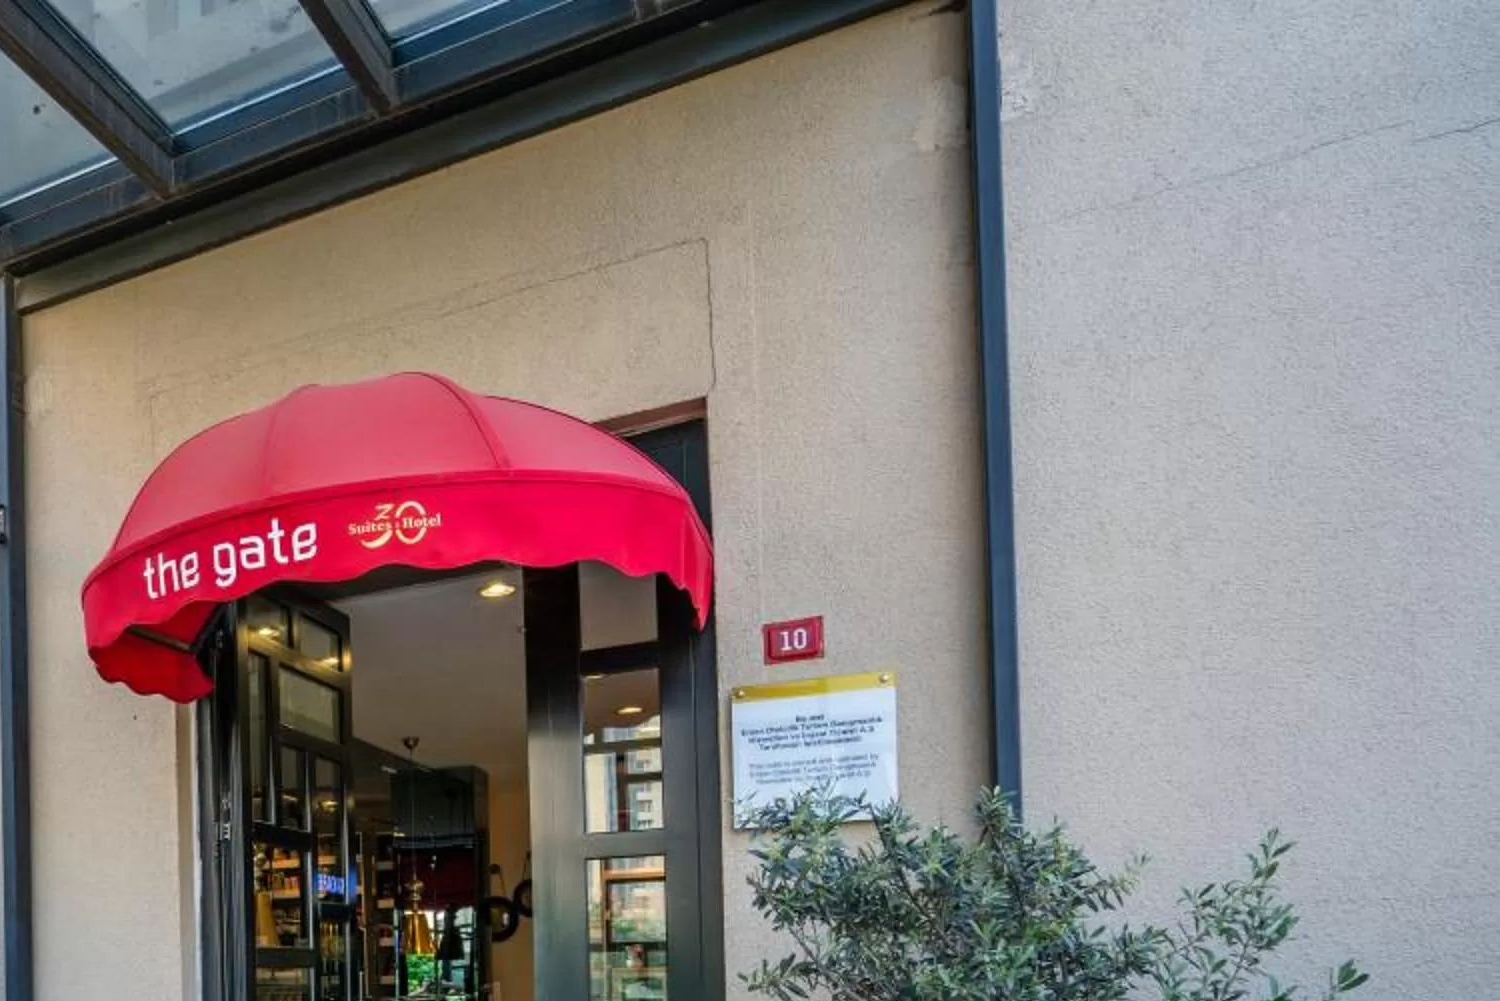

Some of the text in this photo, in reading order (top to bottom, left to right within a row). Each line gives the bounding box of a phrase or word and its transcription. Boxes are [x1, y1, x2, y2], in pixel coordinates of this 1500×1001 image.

[348, 512, 442, 536] Suites Hotel
[143, 517, 318, 600] the gate
[779, 628, 807, 651] 10
